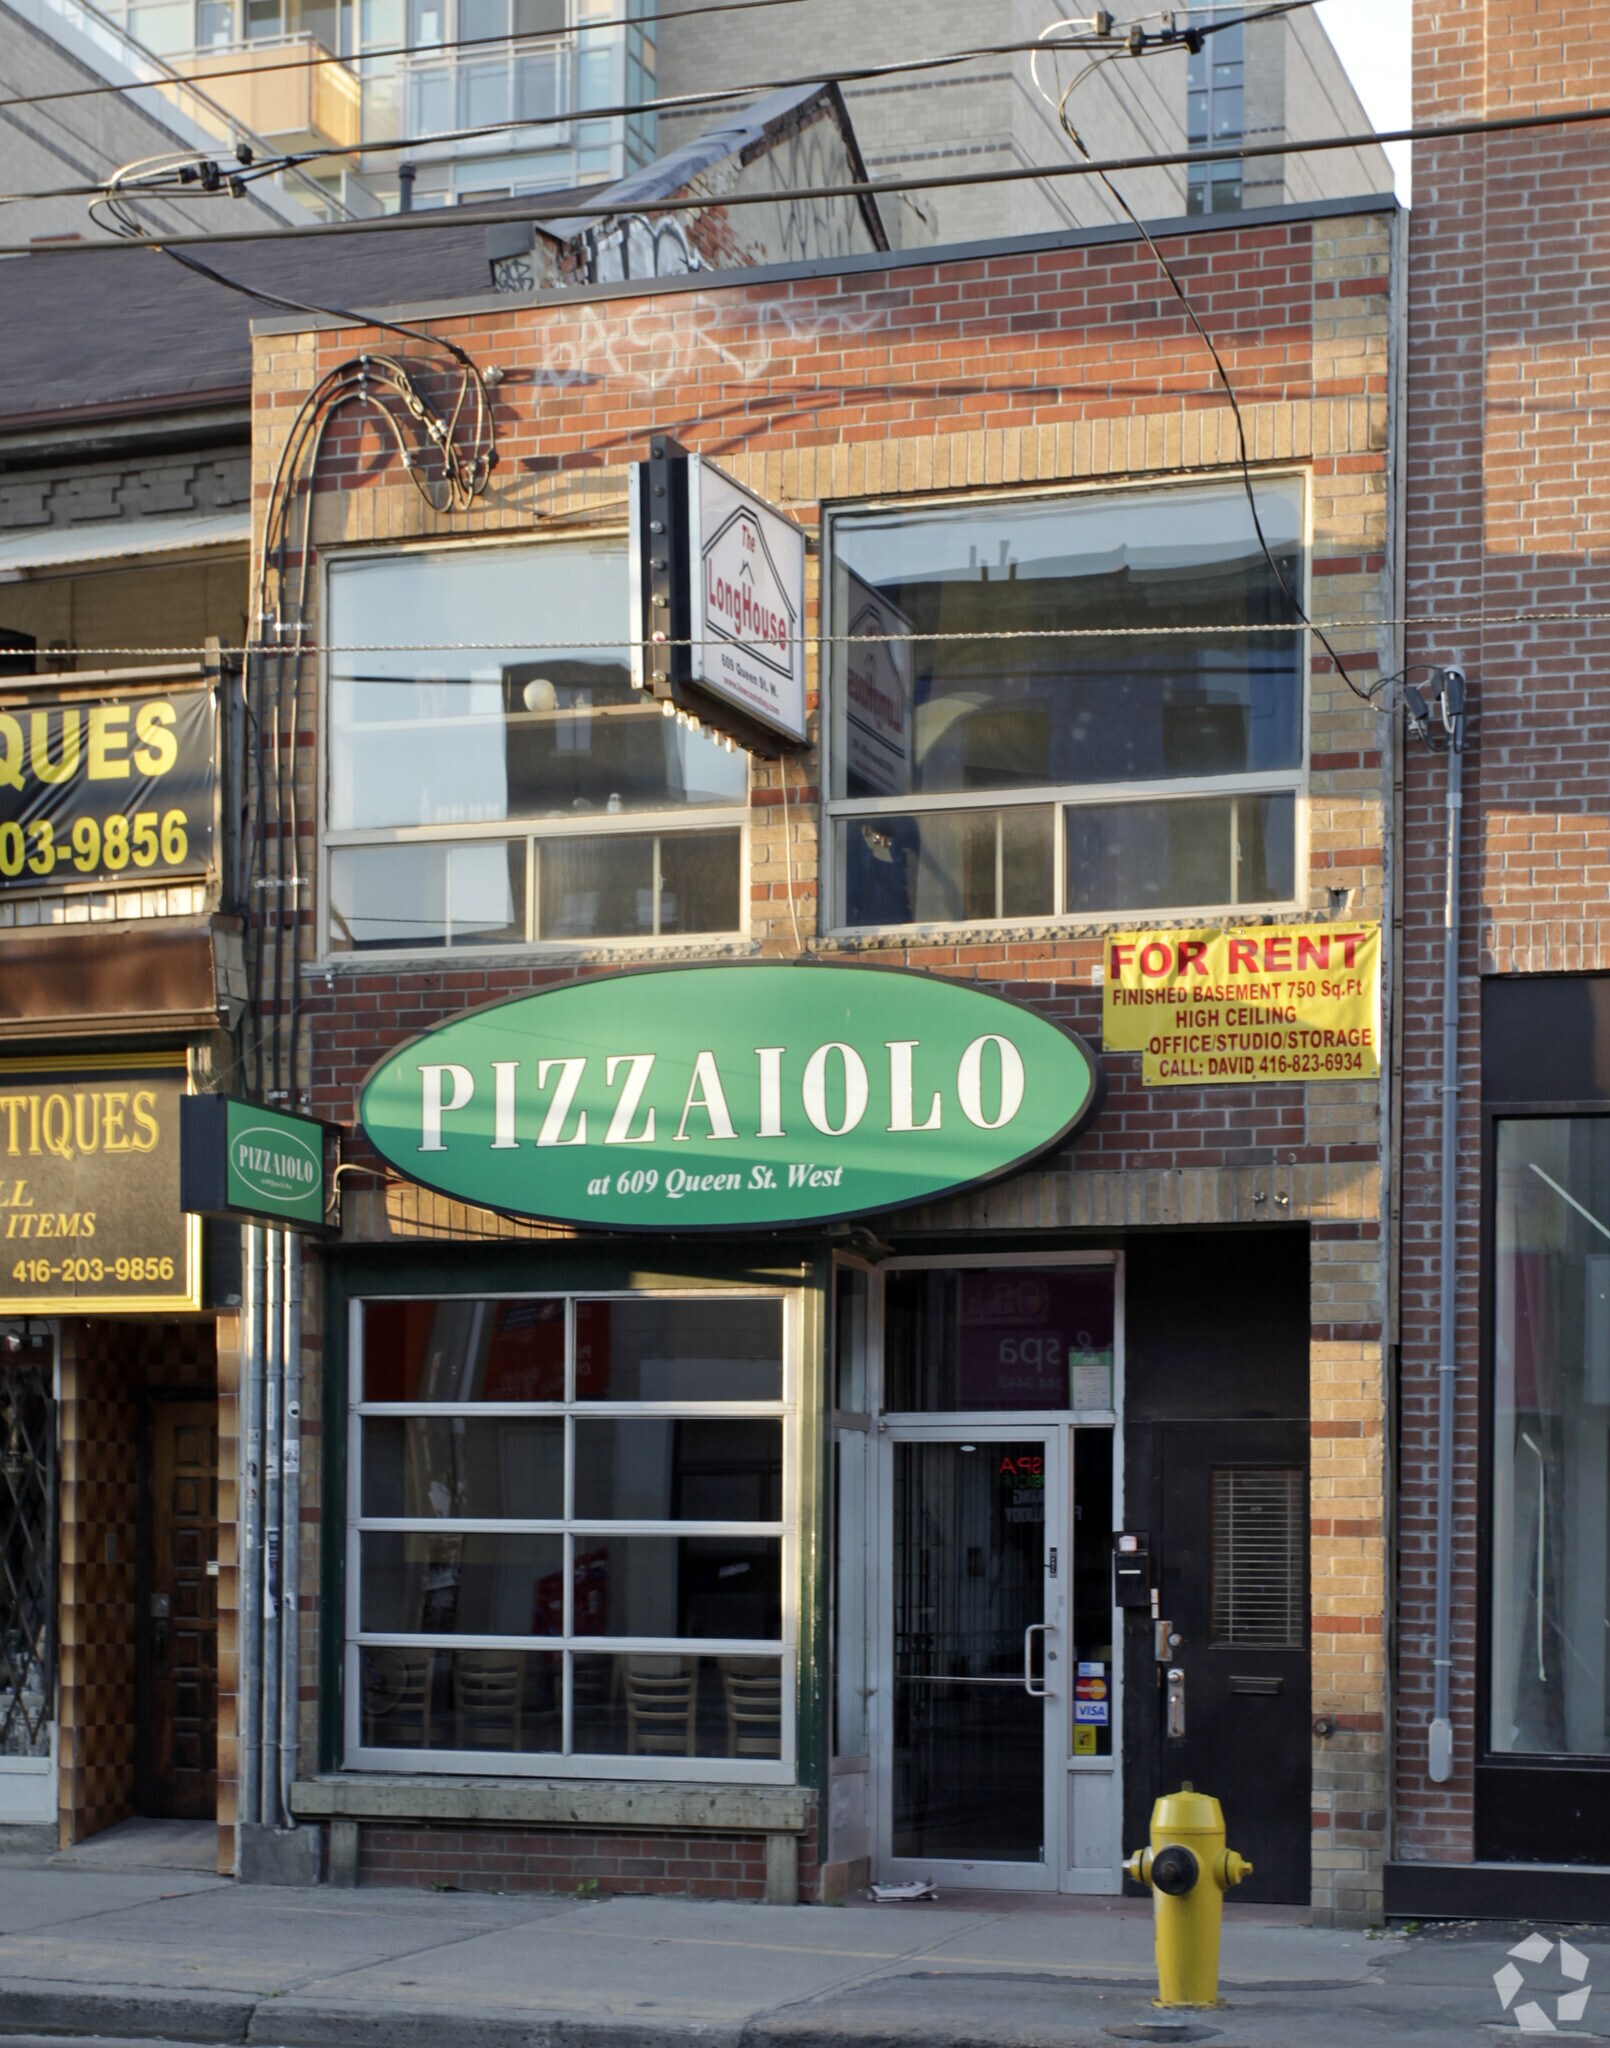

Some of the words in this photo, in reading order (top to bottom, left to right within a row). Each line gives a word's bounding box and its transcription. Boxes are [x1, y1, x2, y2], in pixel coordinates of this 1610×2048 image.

[742, 524, 755, 553] The
[709, 558, 786, 651] LongHouse
[721, 653, 734, 671] 609
[736, 662, 757, 686] Queen
[1111, 941, 1208, 980] FOR
[1229, 933, 1366, 975] RENT
[1113, 986, 1187, 1006] FINISHED
[1193, 982, 1281, 1003] BASEMENT
[1288, 980, 1315, 998] 750
[1321, 979, 1362, 1000] Sq.Ft
[1176, 1009, 1219, 1028] HIGH
[1226, 1006, 1297, 1027] CEILING
[1150, 1028, 1372, 1054] OFFICE/STUDIO/STORAGE
[1159, 1058, 1203, 1078] CALL:
[1208, 1056, 1254, 1075] DAVID
[1259, 1052, 1362, 1074] 416-823-6934
[417, 1034, 1026, 1152] PIZZAIOLO
[0, 1090, 160, 1161] TIQUES
[239, 1143, 314, 1184] PIZZAIOLO
[587, 1174, 611, 1195] at
[616, 1169, 659, 1194] 609
[665, 1168, 741, 1199] Queen
[748, 1165, 778, 1190] St.
[787, 1164, 844, 1188] West
[6, 1212, 96, 1238] ITEMS
[13, 1257, 174, 1283] 416-203-9856
[1079, 1705, 1105, 1716] VISA
